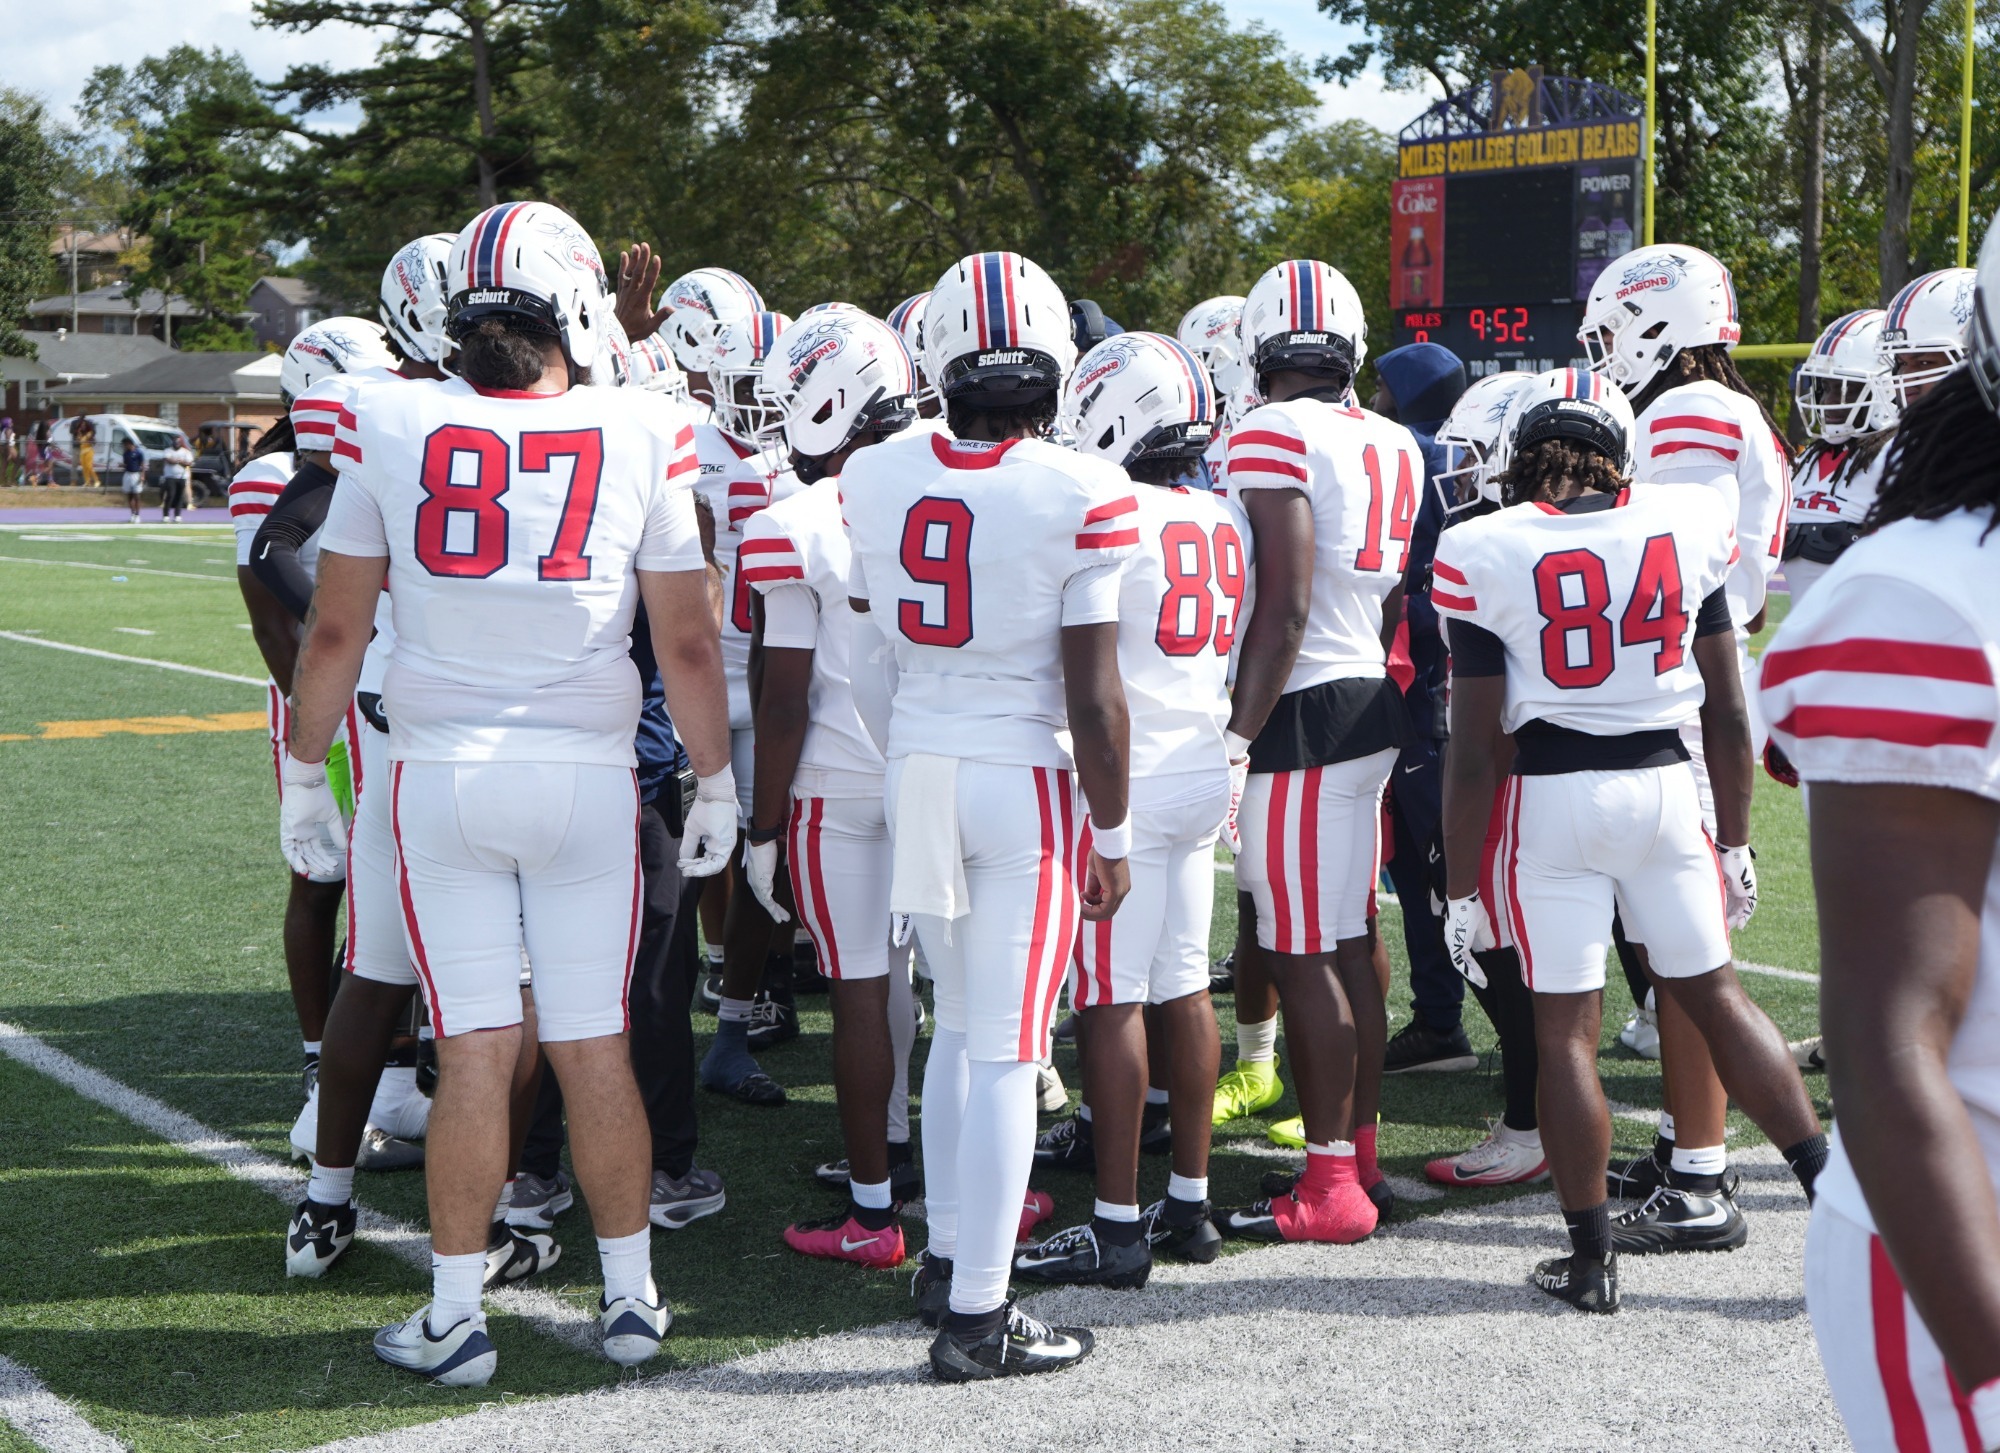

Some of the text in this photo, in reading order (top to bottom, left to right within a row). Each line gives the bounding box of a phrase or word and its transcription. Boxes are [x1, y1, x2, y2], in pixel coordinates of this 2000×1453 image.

[1400, 122, 1639, 178] MILES COLLEGE GOLDEN BEARS
[1580, 174, 1631, 193] POWER
[1397, 193, 1438, 215] Coke
[395, 261, 419, 305] DRAGONS
[1615, 276, 1668, 300] DRAGONS
[468, 288, 511, 305] schutt
[1405, 313, 1442, 328] MILES
[1289, 331, 1329, 345] schutt
[978, 349, 1028, 367] schutt
[1469, 359, 1501, 377] TO GO
[1075, 361, 1119, 395] DRAGONS
[1557, 399, 1602, 418] schutt
[957, 441, 980, 449] NIKE
[414, 423, 604, 581] 87
[1354, 444, 1415, 574] 14
[899, 495, 975, 648] 9
[1155, 521, 1246, 657] 89
[1532, 532, 1690, 689] 84
